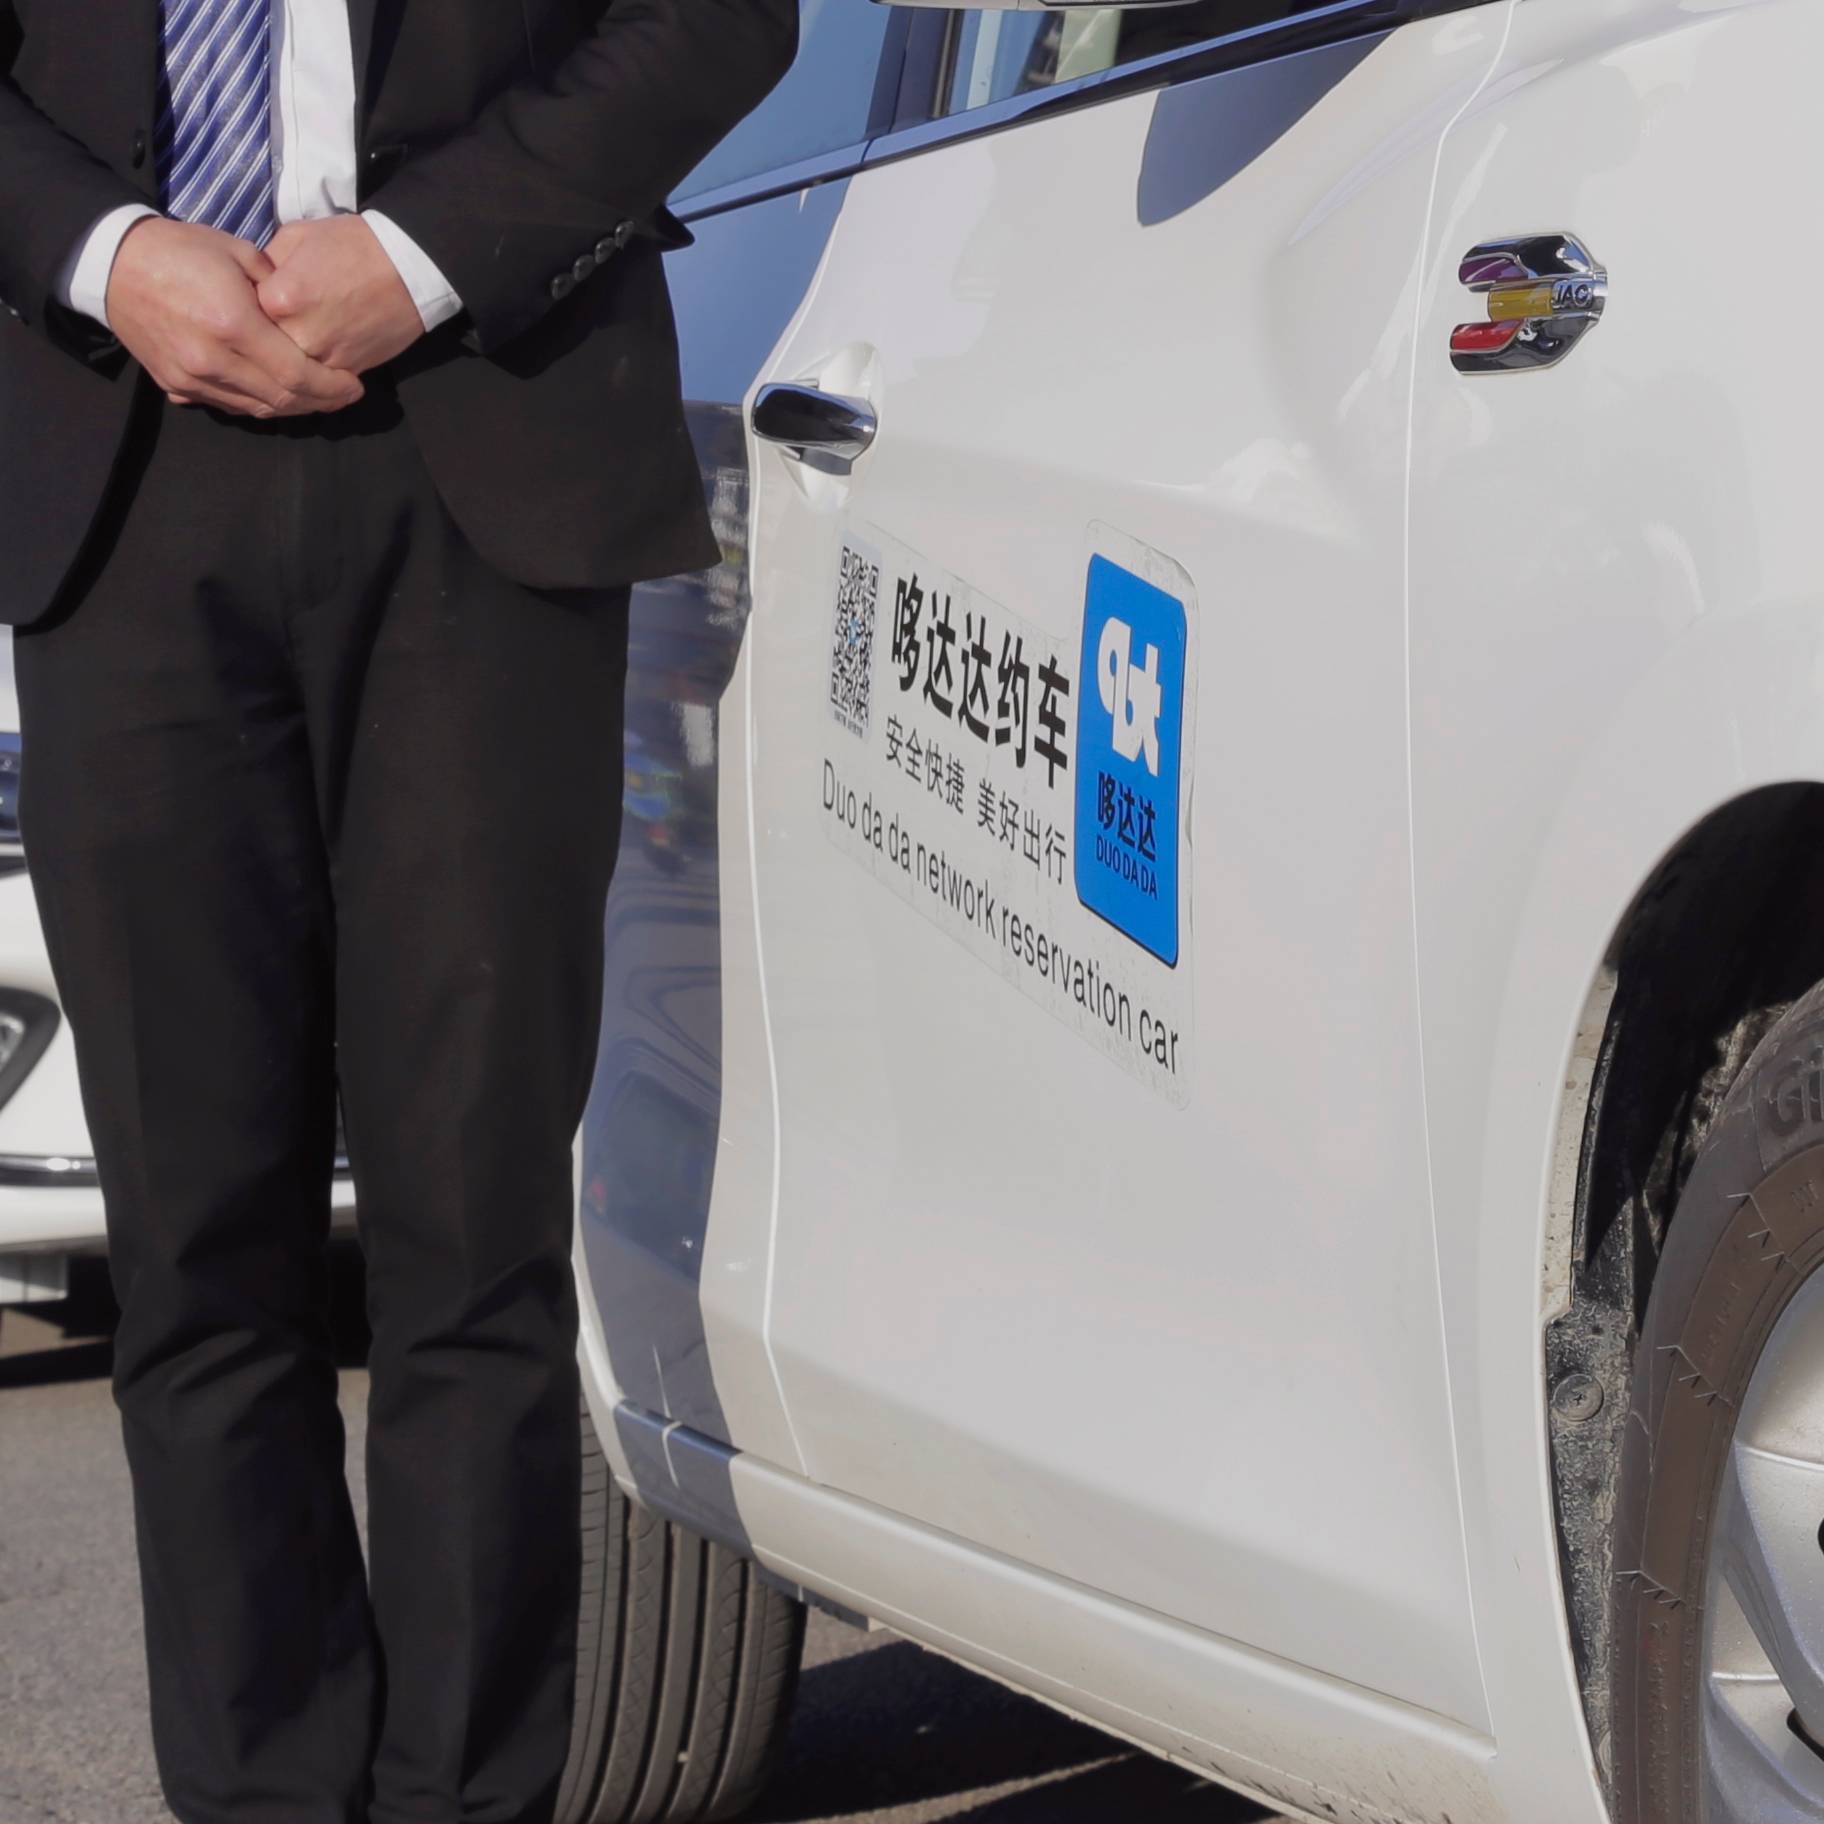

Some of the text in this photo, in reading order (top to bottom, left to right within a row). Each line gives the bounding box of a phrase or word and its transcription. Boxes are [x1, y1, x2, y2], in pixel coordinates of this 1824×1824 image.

[891, 572, 1070, 790] 哆达达约车
[886, 714, 1067, 885] 安全快捷 美好出行
[1096, 834, 1158, 900] DUO DA DA
[1097, 771, 1156, 862] 哆达达
[823, 758, 1178, 1074] Duo da da network reservation car
